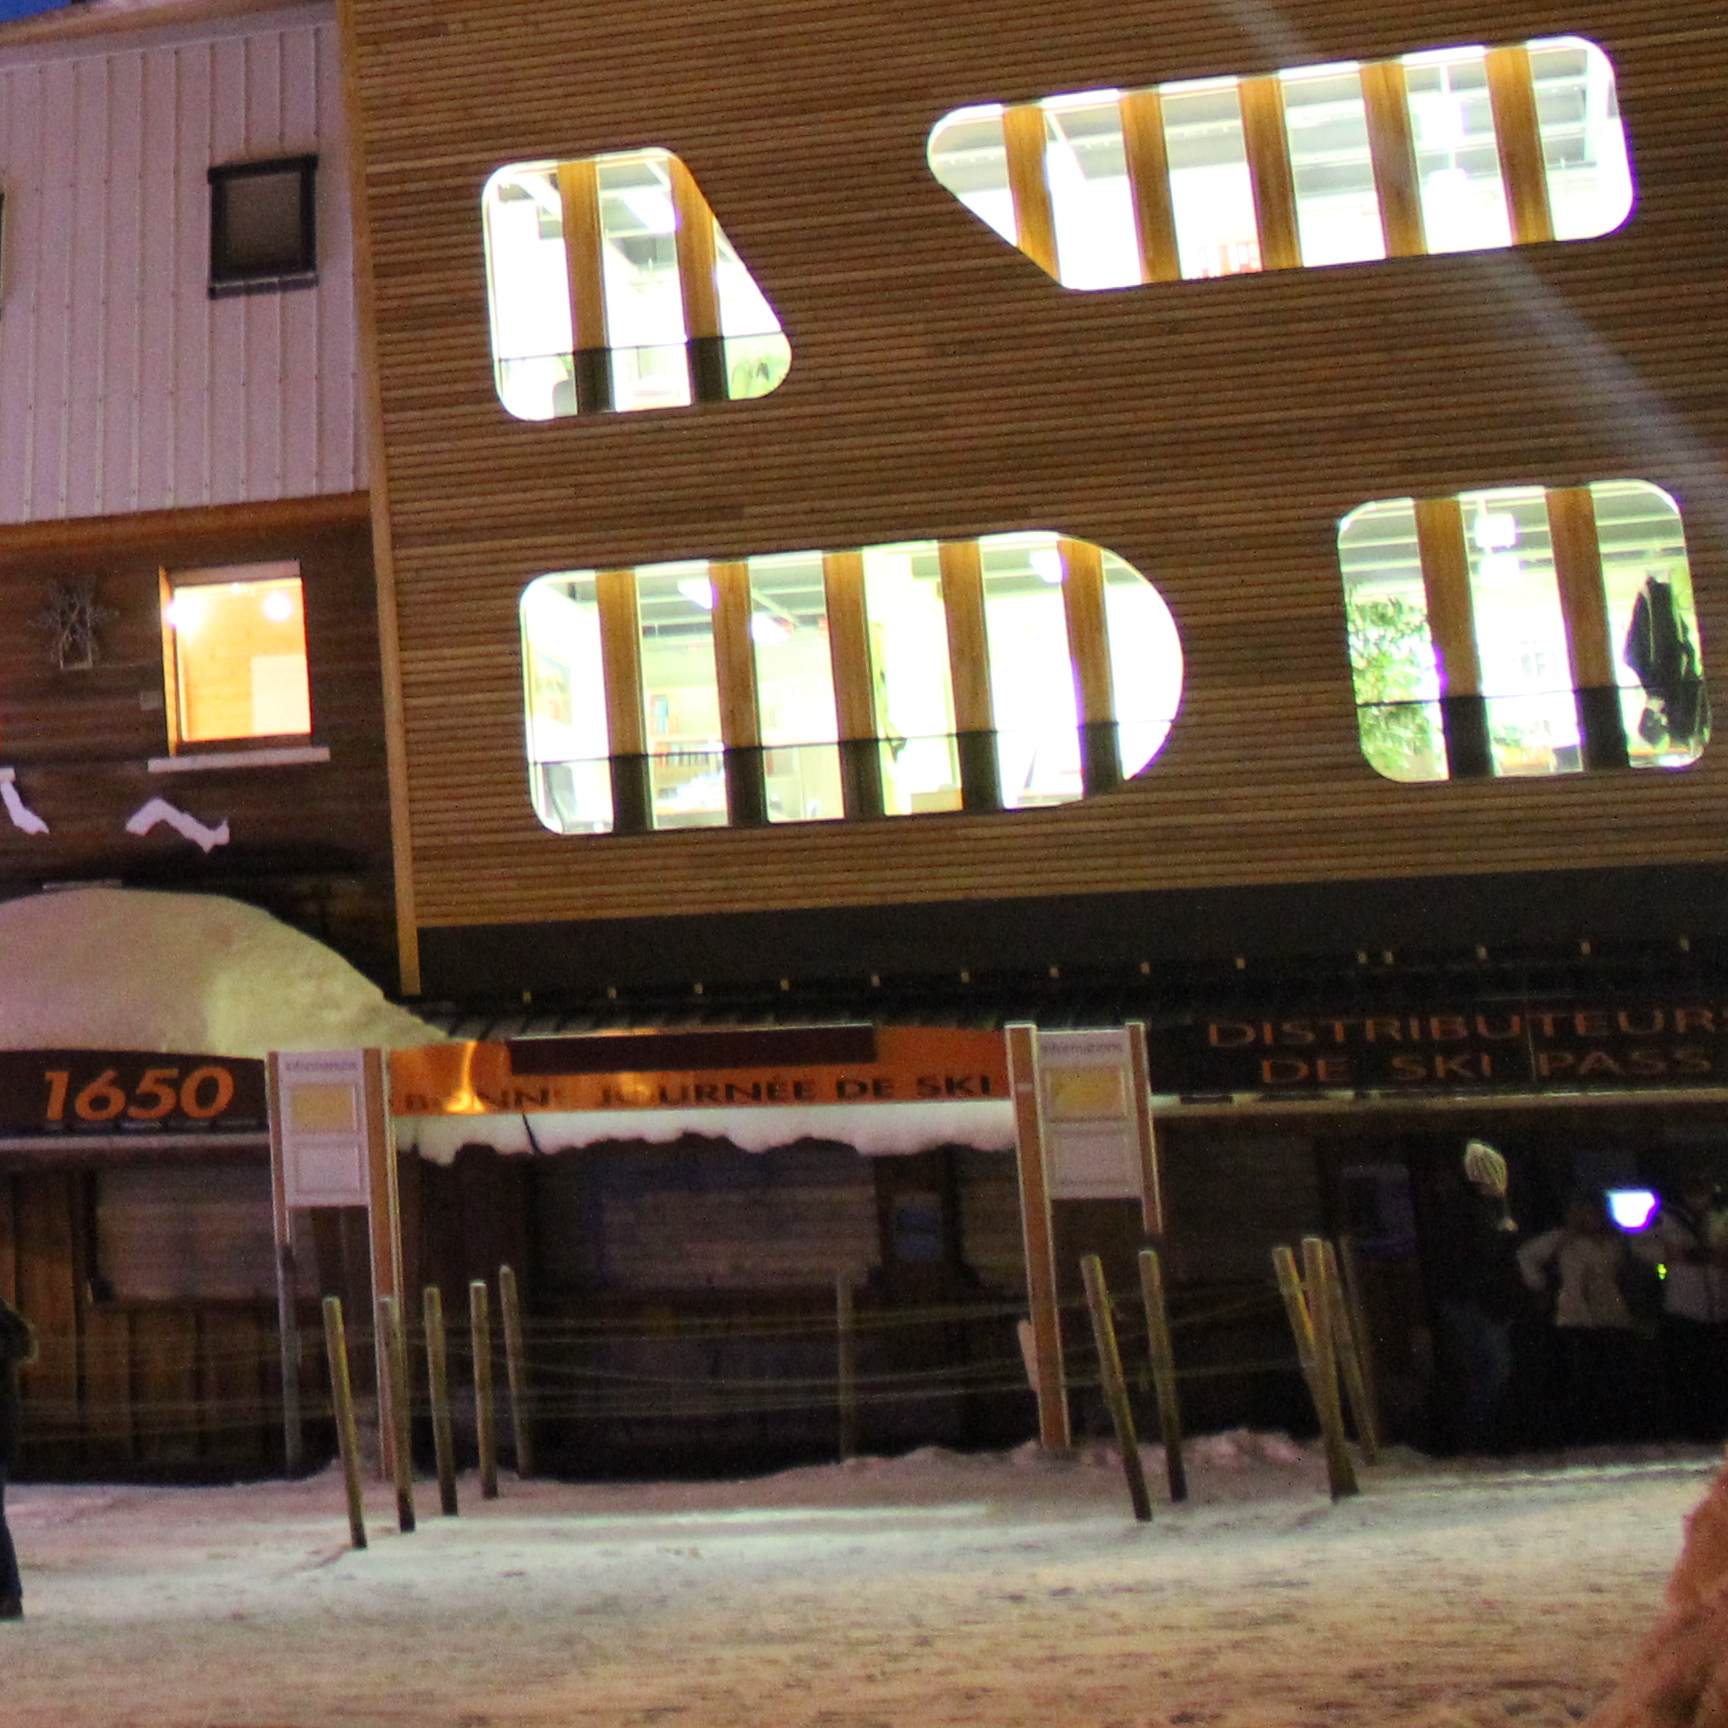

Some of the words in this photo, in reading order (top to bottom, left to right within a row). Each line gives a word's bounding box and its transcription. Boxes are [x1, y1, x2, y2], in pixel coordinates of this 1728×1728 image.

[1209, 1008, 1728, 1047] DISTRIBUTEUR
[1262, 1058, 1347, 1083] DE
[1391, 1054, 1491, 1082] SKI
[1539, 1051, 1713, 1077] PASS
[45, 1066, 234, 1121] 1650
[837, 1078, 894, 1100] DE
[915, 1075, 991, 1097] SKI
